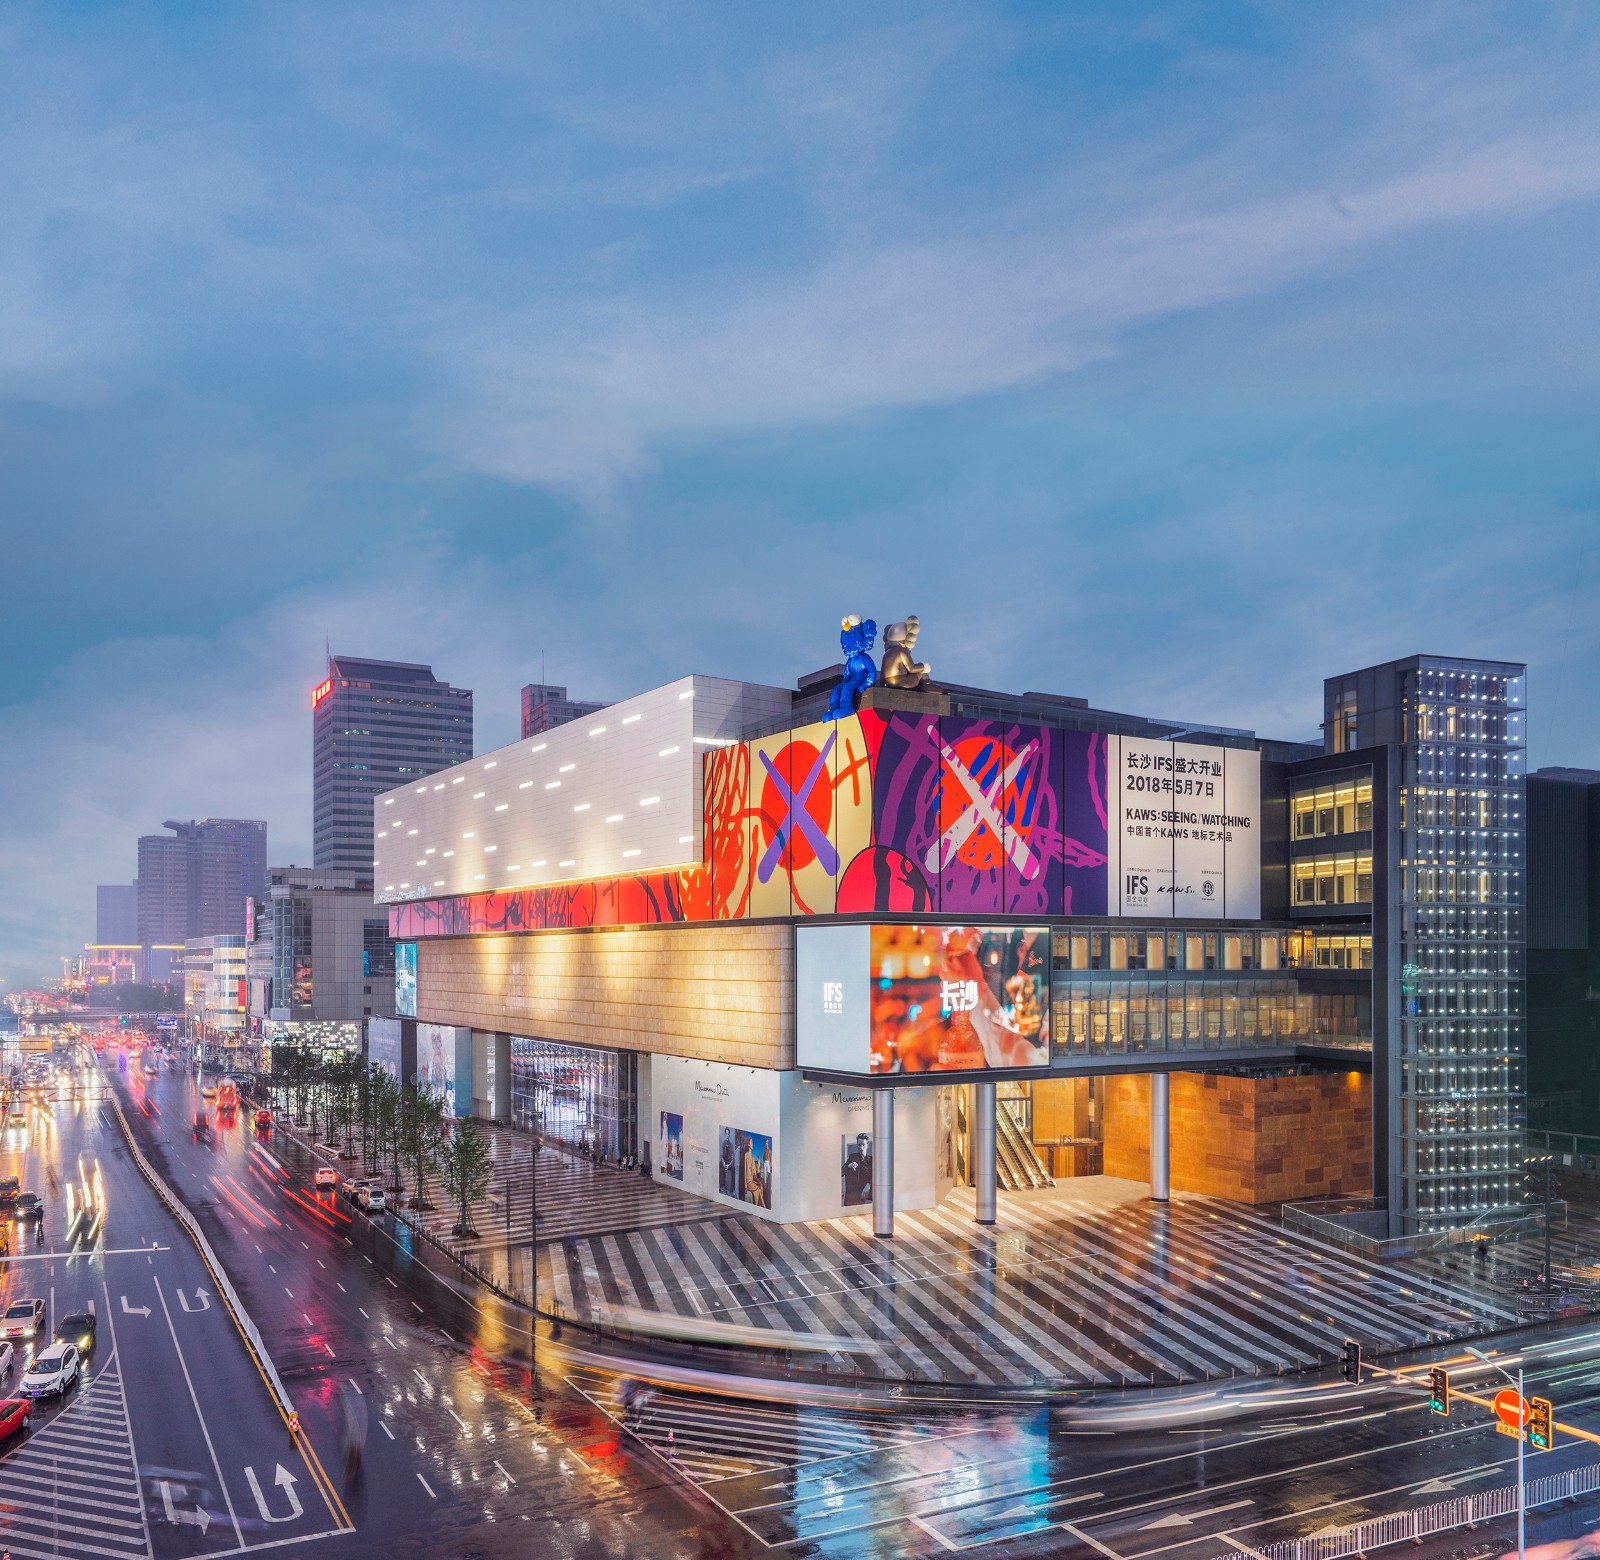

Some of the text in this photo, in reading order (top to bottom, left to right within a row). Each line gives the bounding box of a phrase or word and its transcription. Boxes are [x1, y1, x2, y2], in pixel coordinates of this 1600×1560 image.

[1126, 774, 1214, 797] 2018年5月7日
[1126, 875, 1149, 895] IFS
[823, 982, 843, 1002] IFS
[940, 980, 979, 1012] 长沙
[831, 1092, 872, 1104] Massimo
